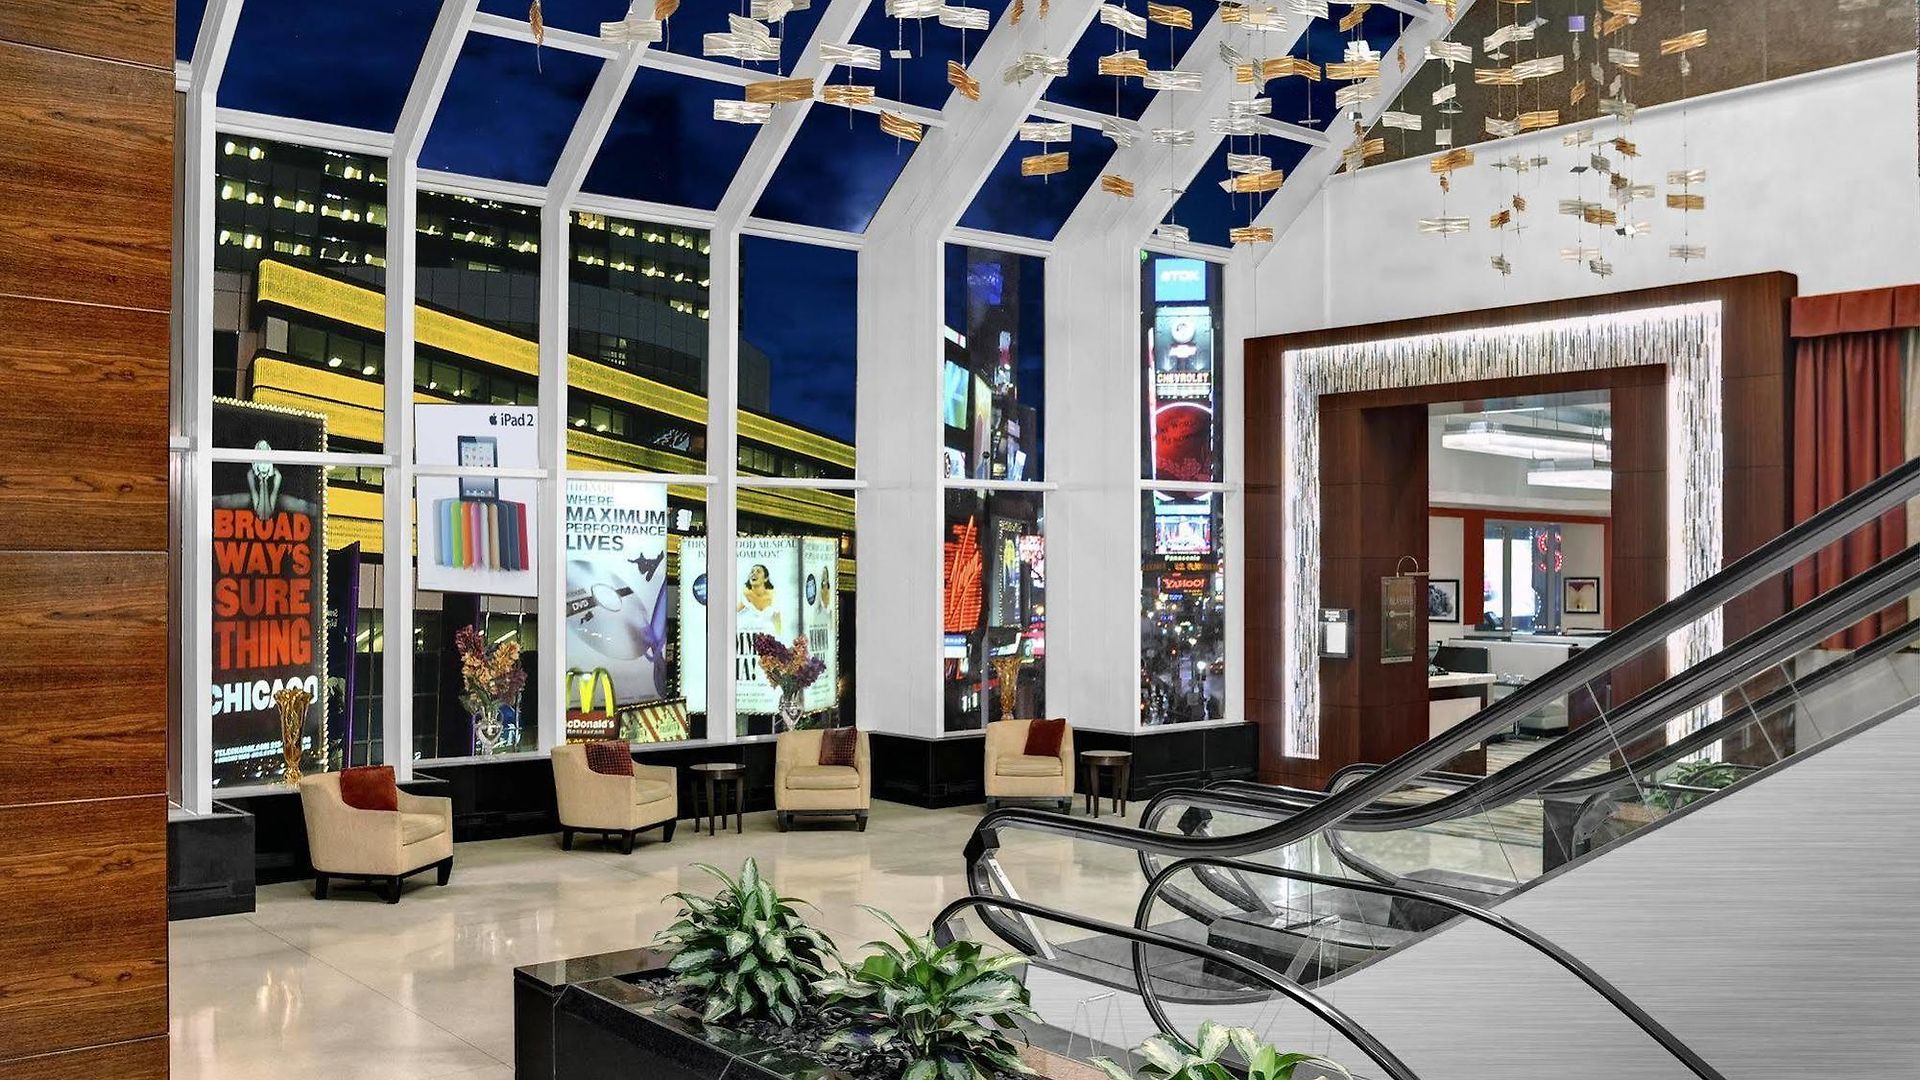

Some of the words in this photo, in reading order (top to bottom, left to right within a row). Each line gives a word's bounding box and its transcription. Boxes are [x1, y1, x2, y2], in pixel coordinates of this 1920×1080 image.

[1157, 372, 1209, 384] CHEVROLET
[501, 412, 525, 427] iPad
[526, 413, 534, 427] 2
[566, 494, 614, 506] WHERE
[566, 506, 665, 526] MAXIMUM
[213, 509, 311, 541] BROAD
[566, 522, 665, 536] PERFORMANCE
[566, 534, 624, 551] LIVES
[213, 541, 311, 576] WAY'S
[1162, 578, 1205, 589] YAHOO!
[215, 578, 311, 617] SURE
[214, 617, 312, 671] THING
[567, 719, 615, 729] cDonald's
